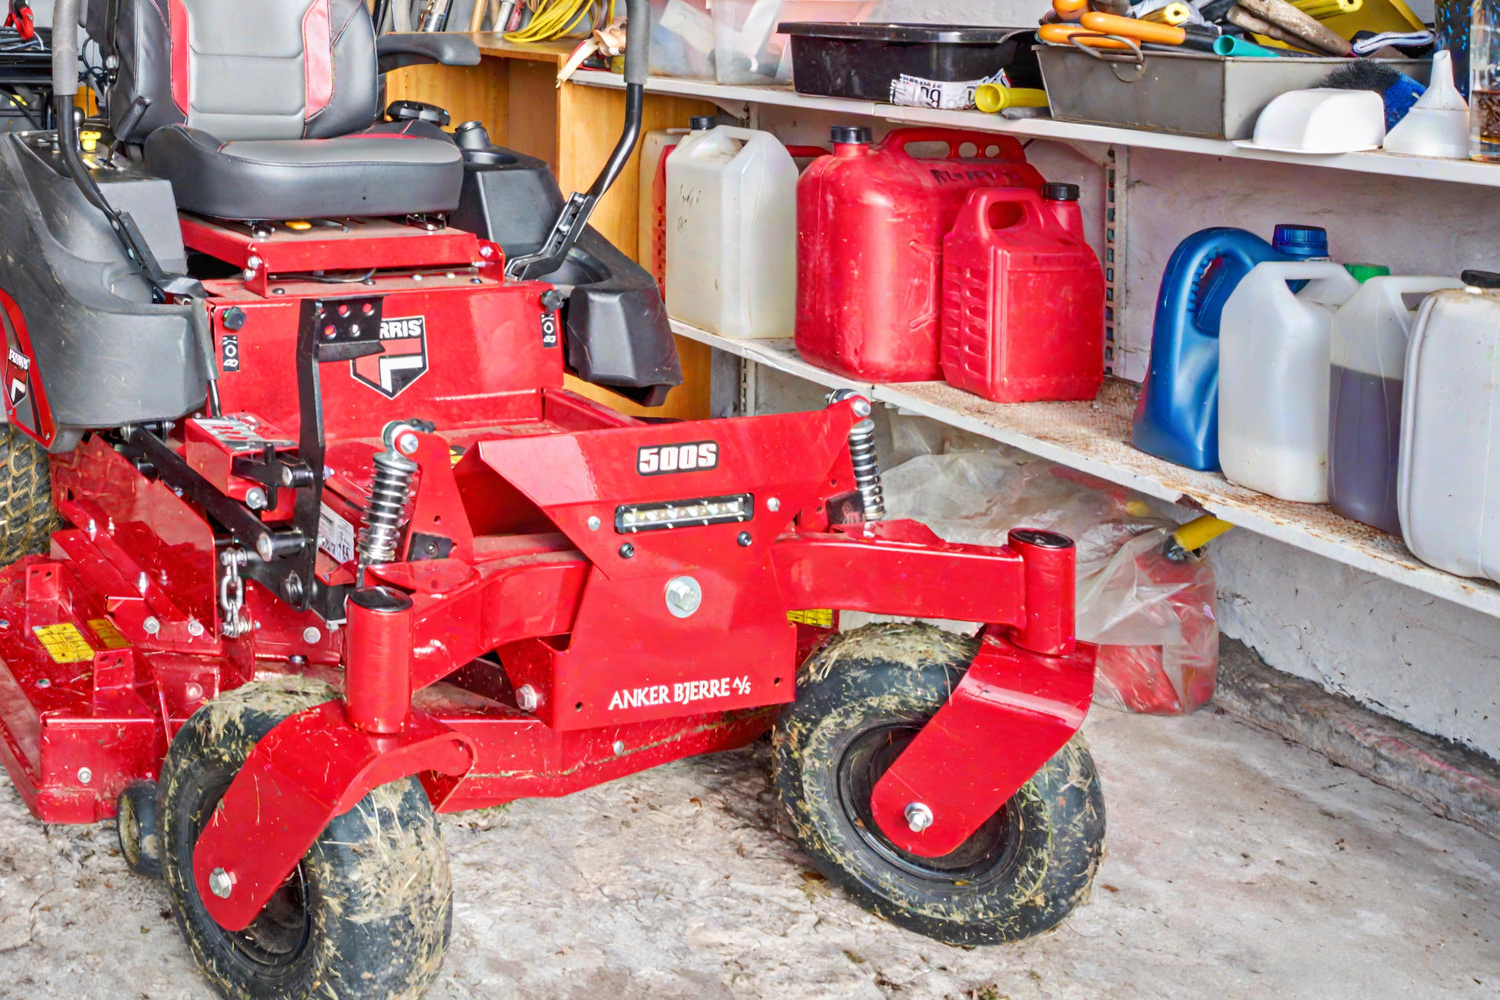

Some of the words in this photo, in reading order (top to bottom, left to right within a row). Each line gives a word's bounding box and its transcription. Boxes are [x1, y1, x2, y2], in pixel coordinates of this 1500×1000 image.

[380, 319, 422, 339] RRIS
[638, 442, 718, 473] 500S
[607, 685, 672, 711] ANKER
[673, 677, 731, 705] BJERRE
